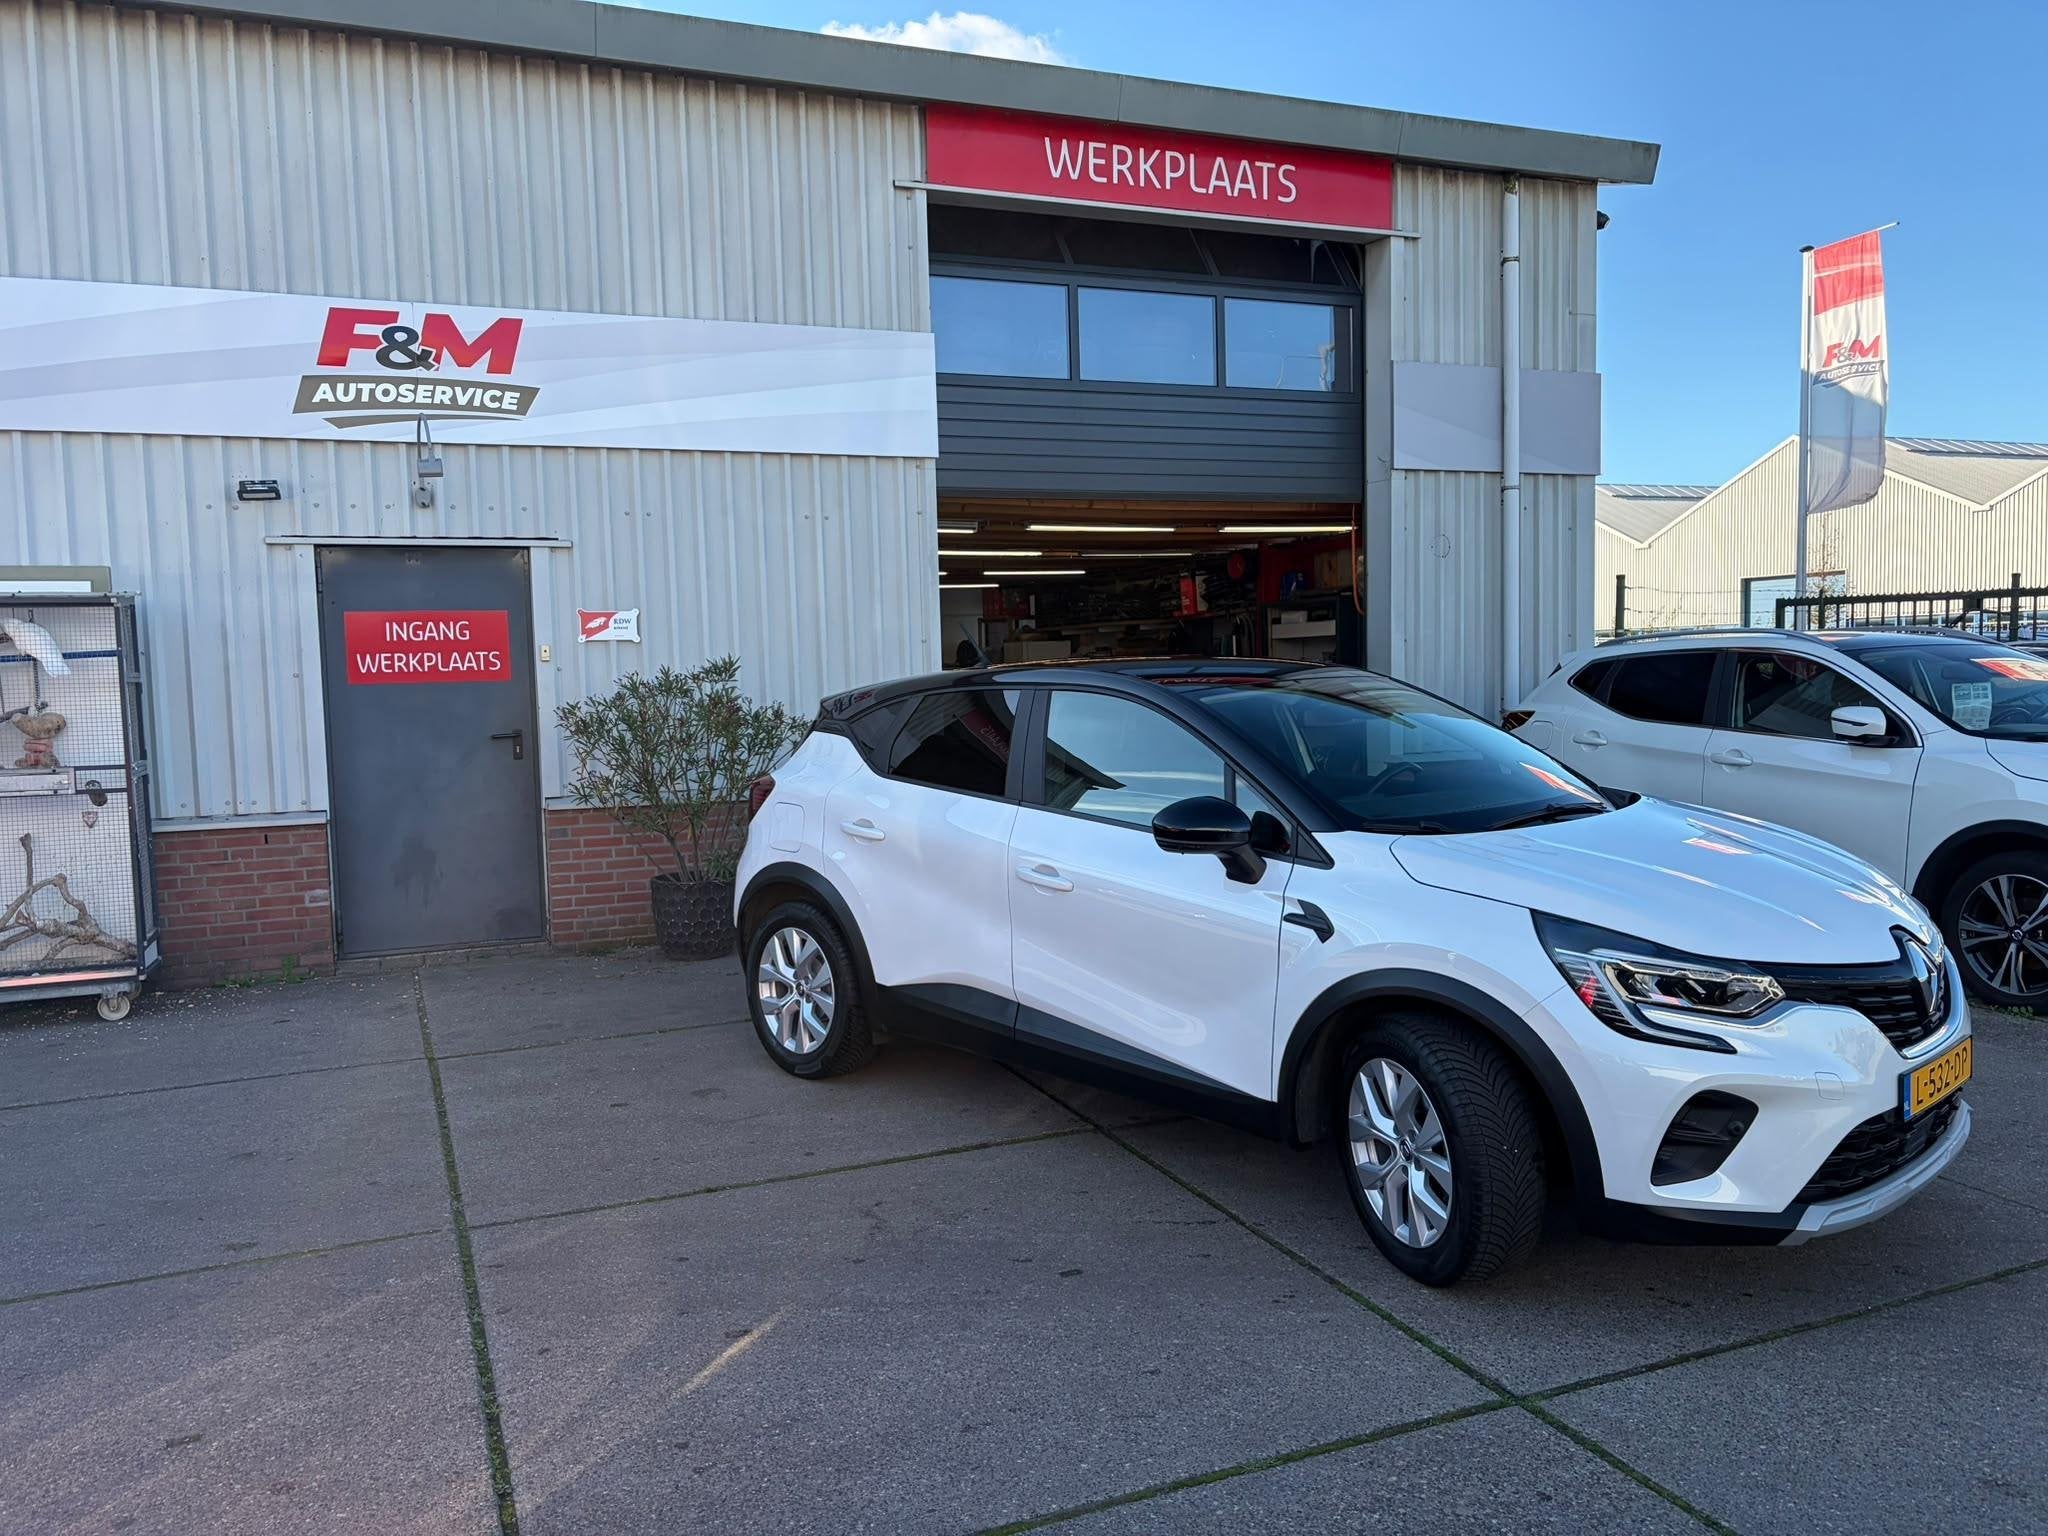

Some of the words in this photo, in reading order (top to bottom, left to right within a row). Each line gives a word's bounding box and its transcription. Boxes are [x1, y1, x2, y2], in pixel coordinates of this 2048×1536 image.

[1044, 136, 1297, 203] WERKPLAATS
[316, 307, 524, 375] F&M
[1822, 335, 1881, 368] F&M
[312, 382, 521, 411] AUTOSERVICE
[385, 620, 470, 642] INGANG
[356, 651, 501, 674] WERKPLAATS
[1916, 1046, 1968, 1106] L-532-DP
